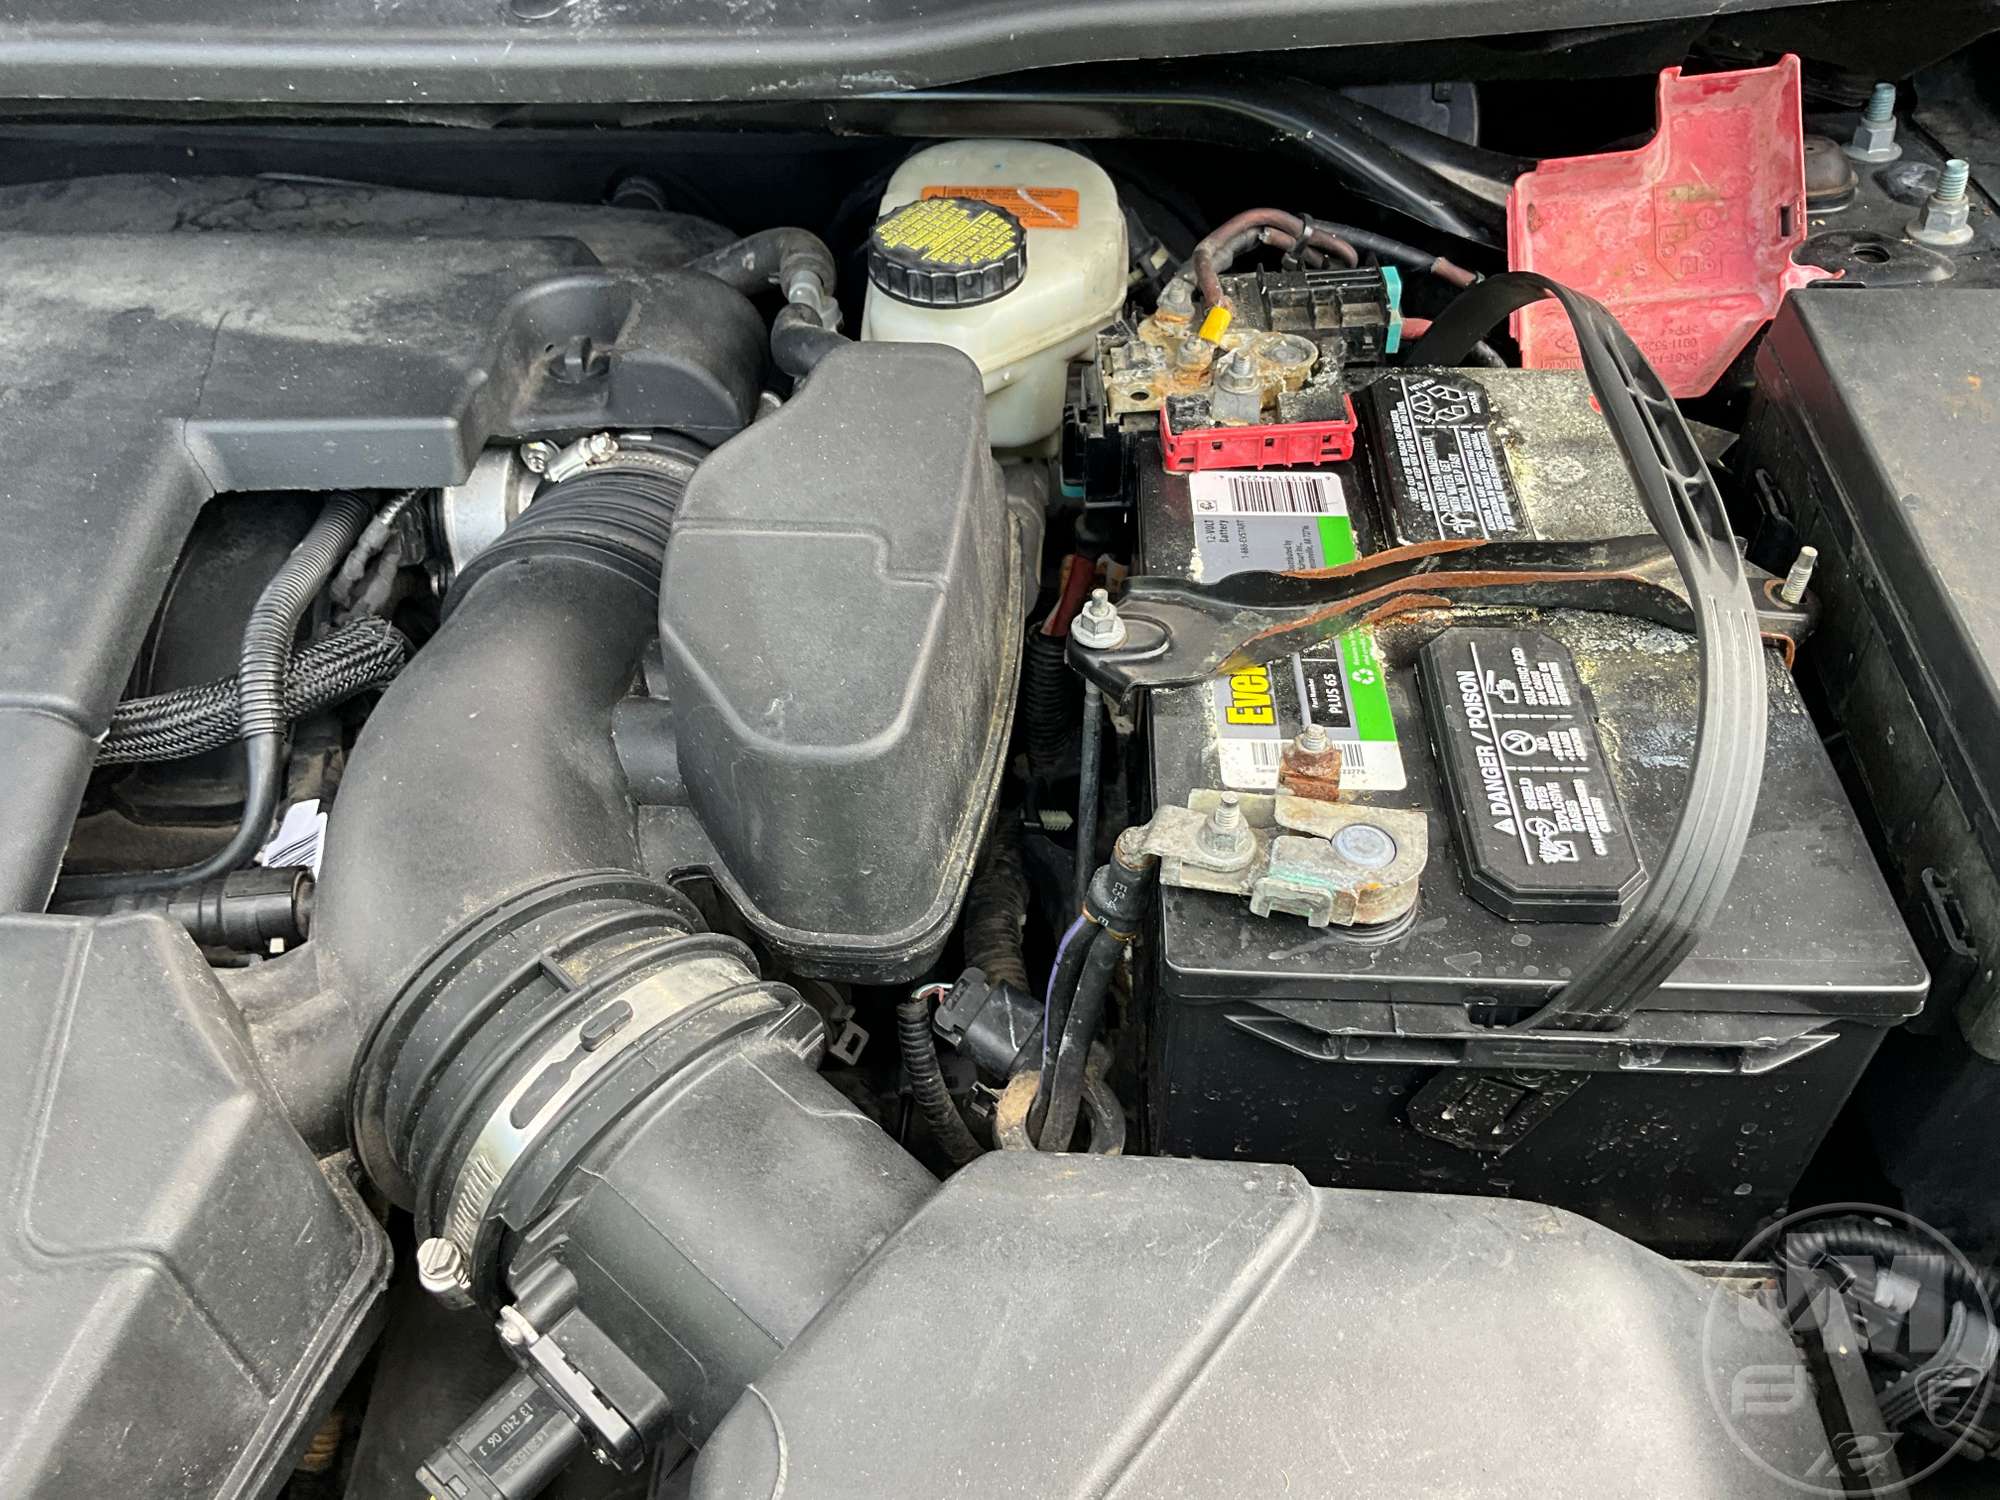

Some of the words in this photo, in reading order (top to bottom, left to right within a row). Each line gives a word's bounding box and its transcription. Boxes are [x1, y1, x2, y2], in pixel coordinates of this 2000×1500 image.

[1204, 520, 1215, 542] 12-VOLT
[1217, 520, 1230, 542] Battery
[1510, 647, 1526, 665] ACID
[1322, 673, 1337, 686] 65
[1516, 667, 1537, 705] SULFURIC
[1529, 670, 1544, 689] CAUSE
[1324, 687, 1342, 713] PLUS
[1455, 670, 1488, 728] POISON
[1536, 737, 1550, 750] NO
[1475, 745, 1511, 815] DANGER
[1518, 777, 1539, 810] SHIELD
[1533, 785, 1551, 809] EYES
[1545, 781, 1571, 831] EXPLOSIVE
[1564, 799, 1586, 831] GASES
[519, 1402, 534, 1417] 13
[501, 1414, 521, 1435] 240
[486, 1429, 503, 1448] 06
